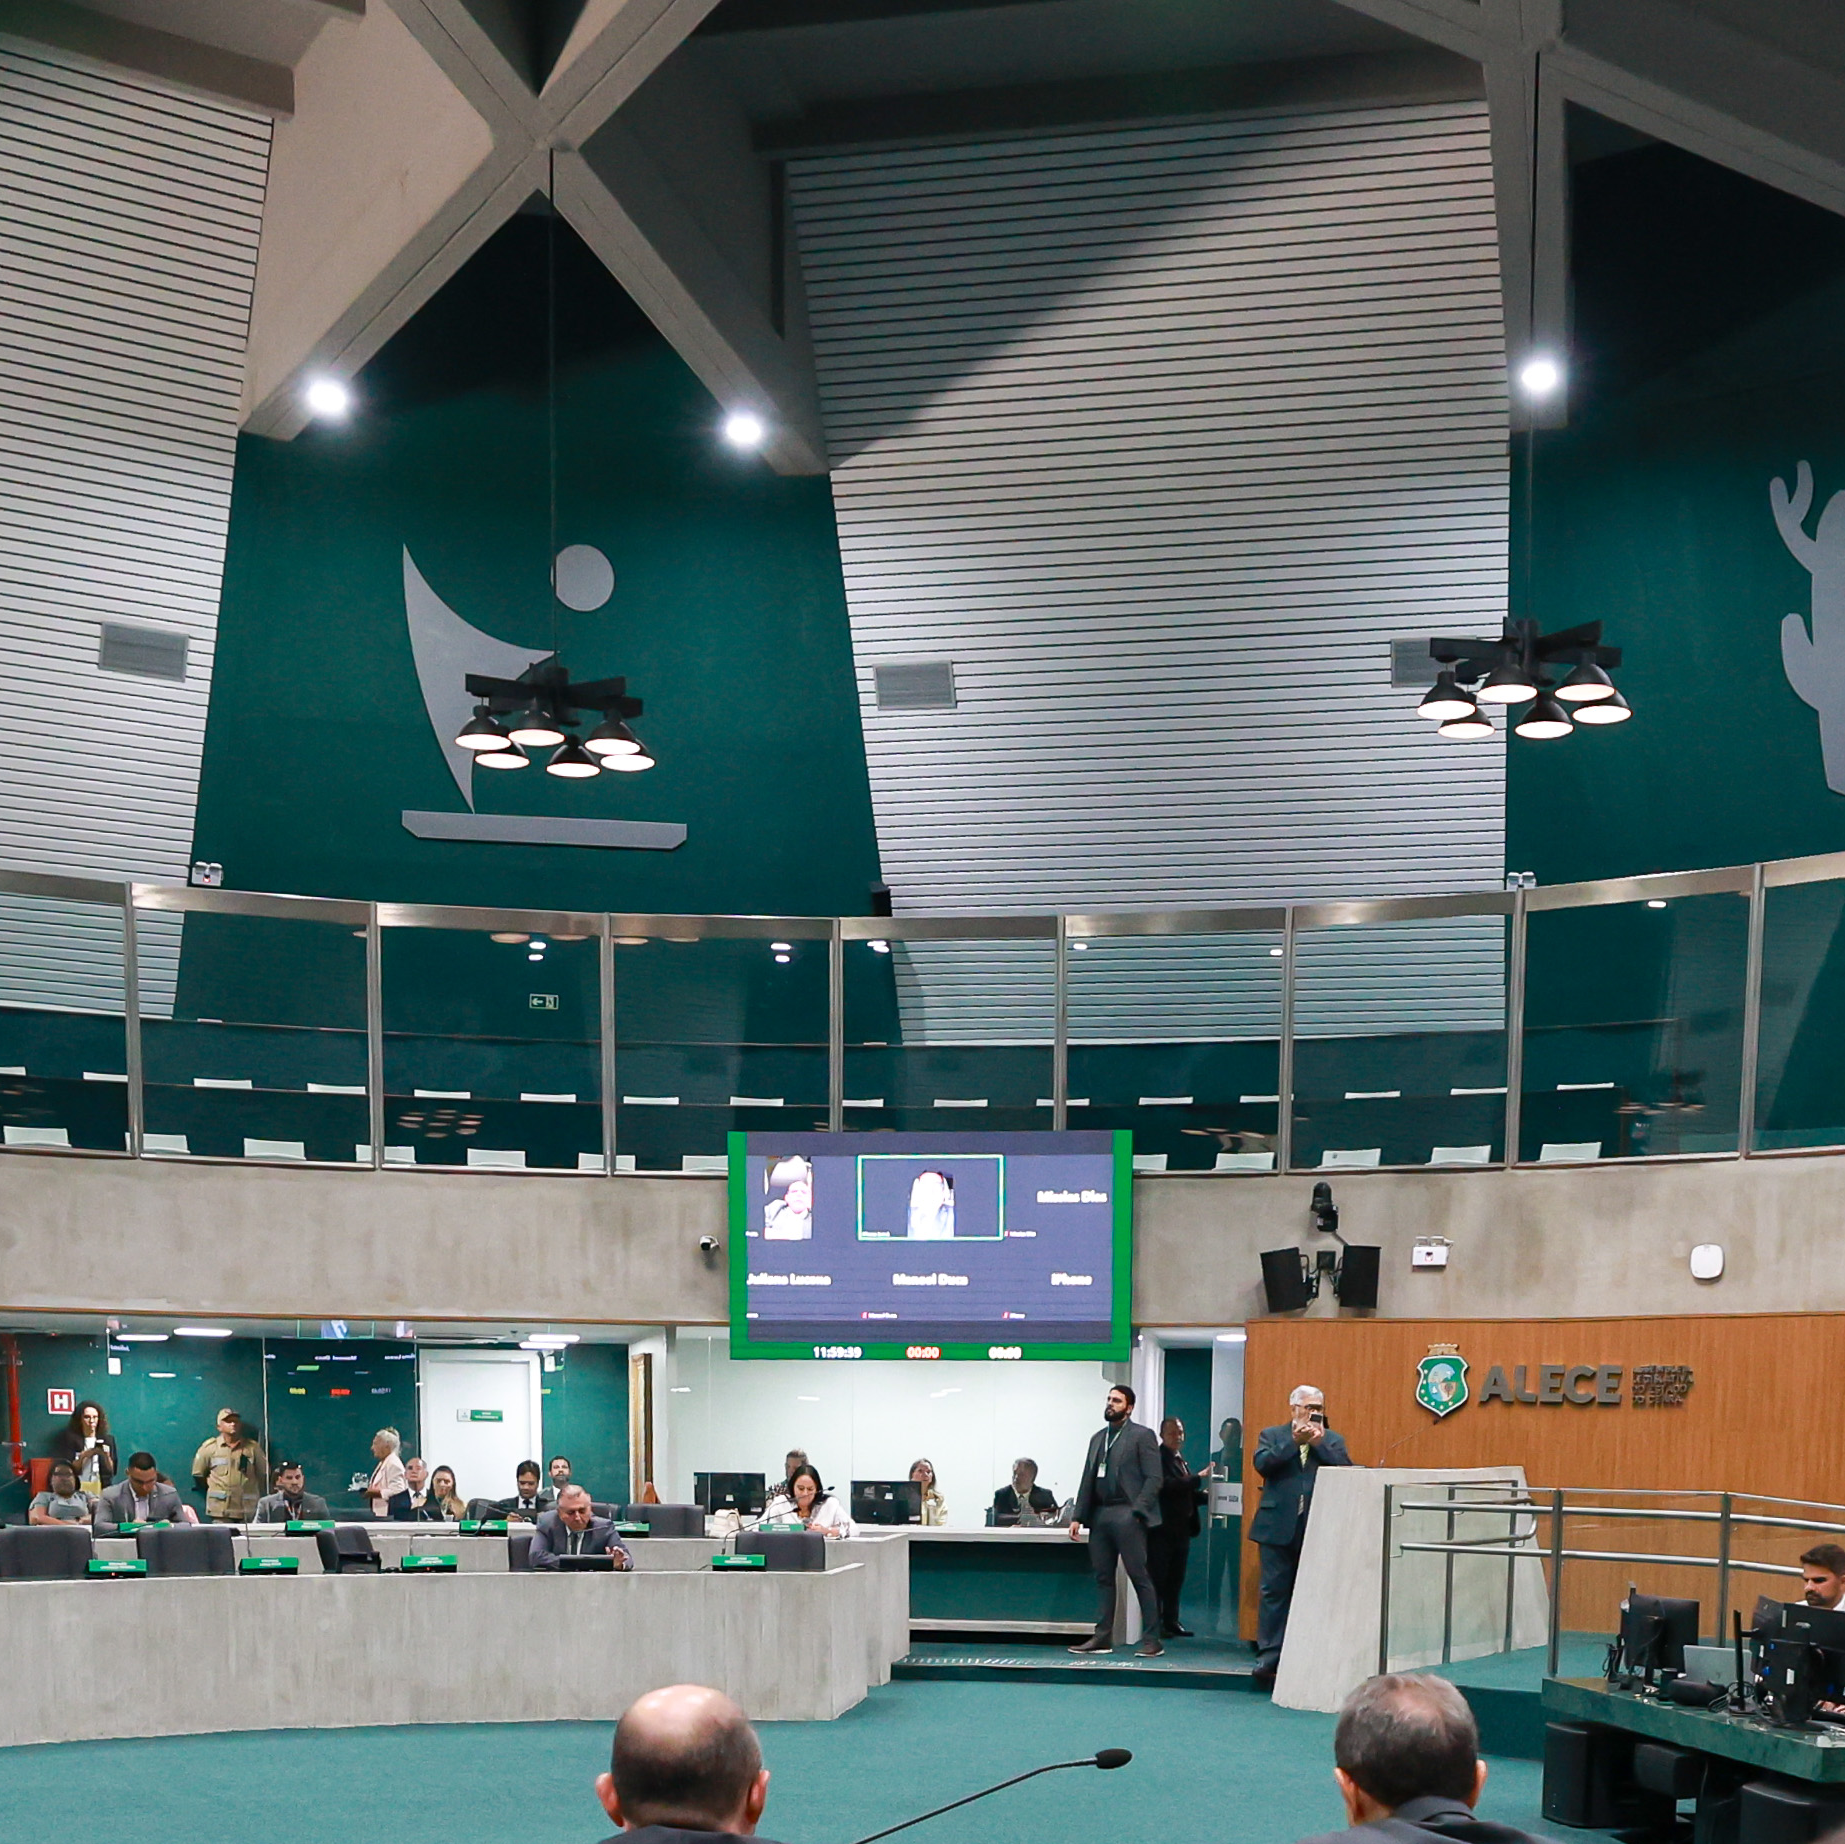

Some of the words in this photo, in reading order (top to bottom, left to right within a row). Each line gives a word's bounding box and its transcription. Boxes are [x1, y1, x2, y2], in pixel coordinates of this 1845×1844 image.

[813, 1346, 863, 1359] 11:59:39
[906, 1346, 940, 1359] 00:00
[1478, 1364, 1623, 1404] ALECE
[53, 1394, 69, 1409] H
